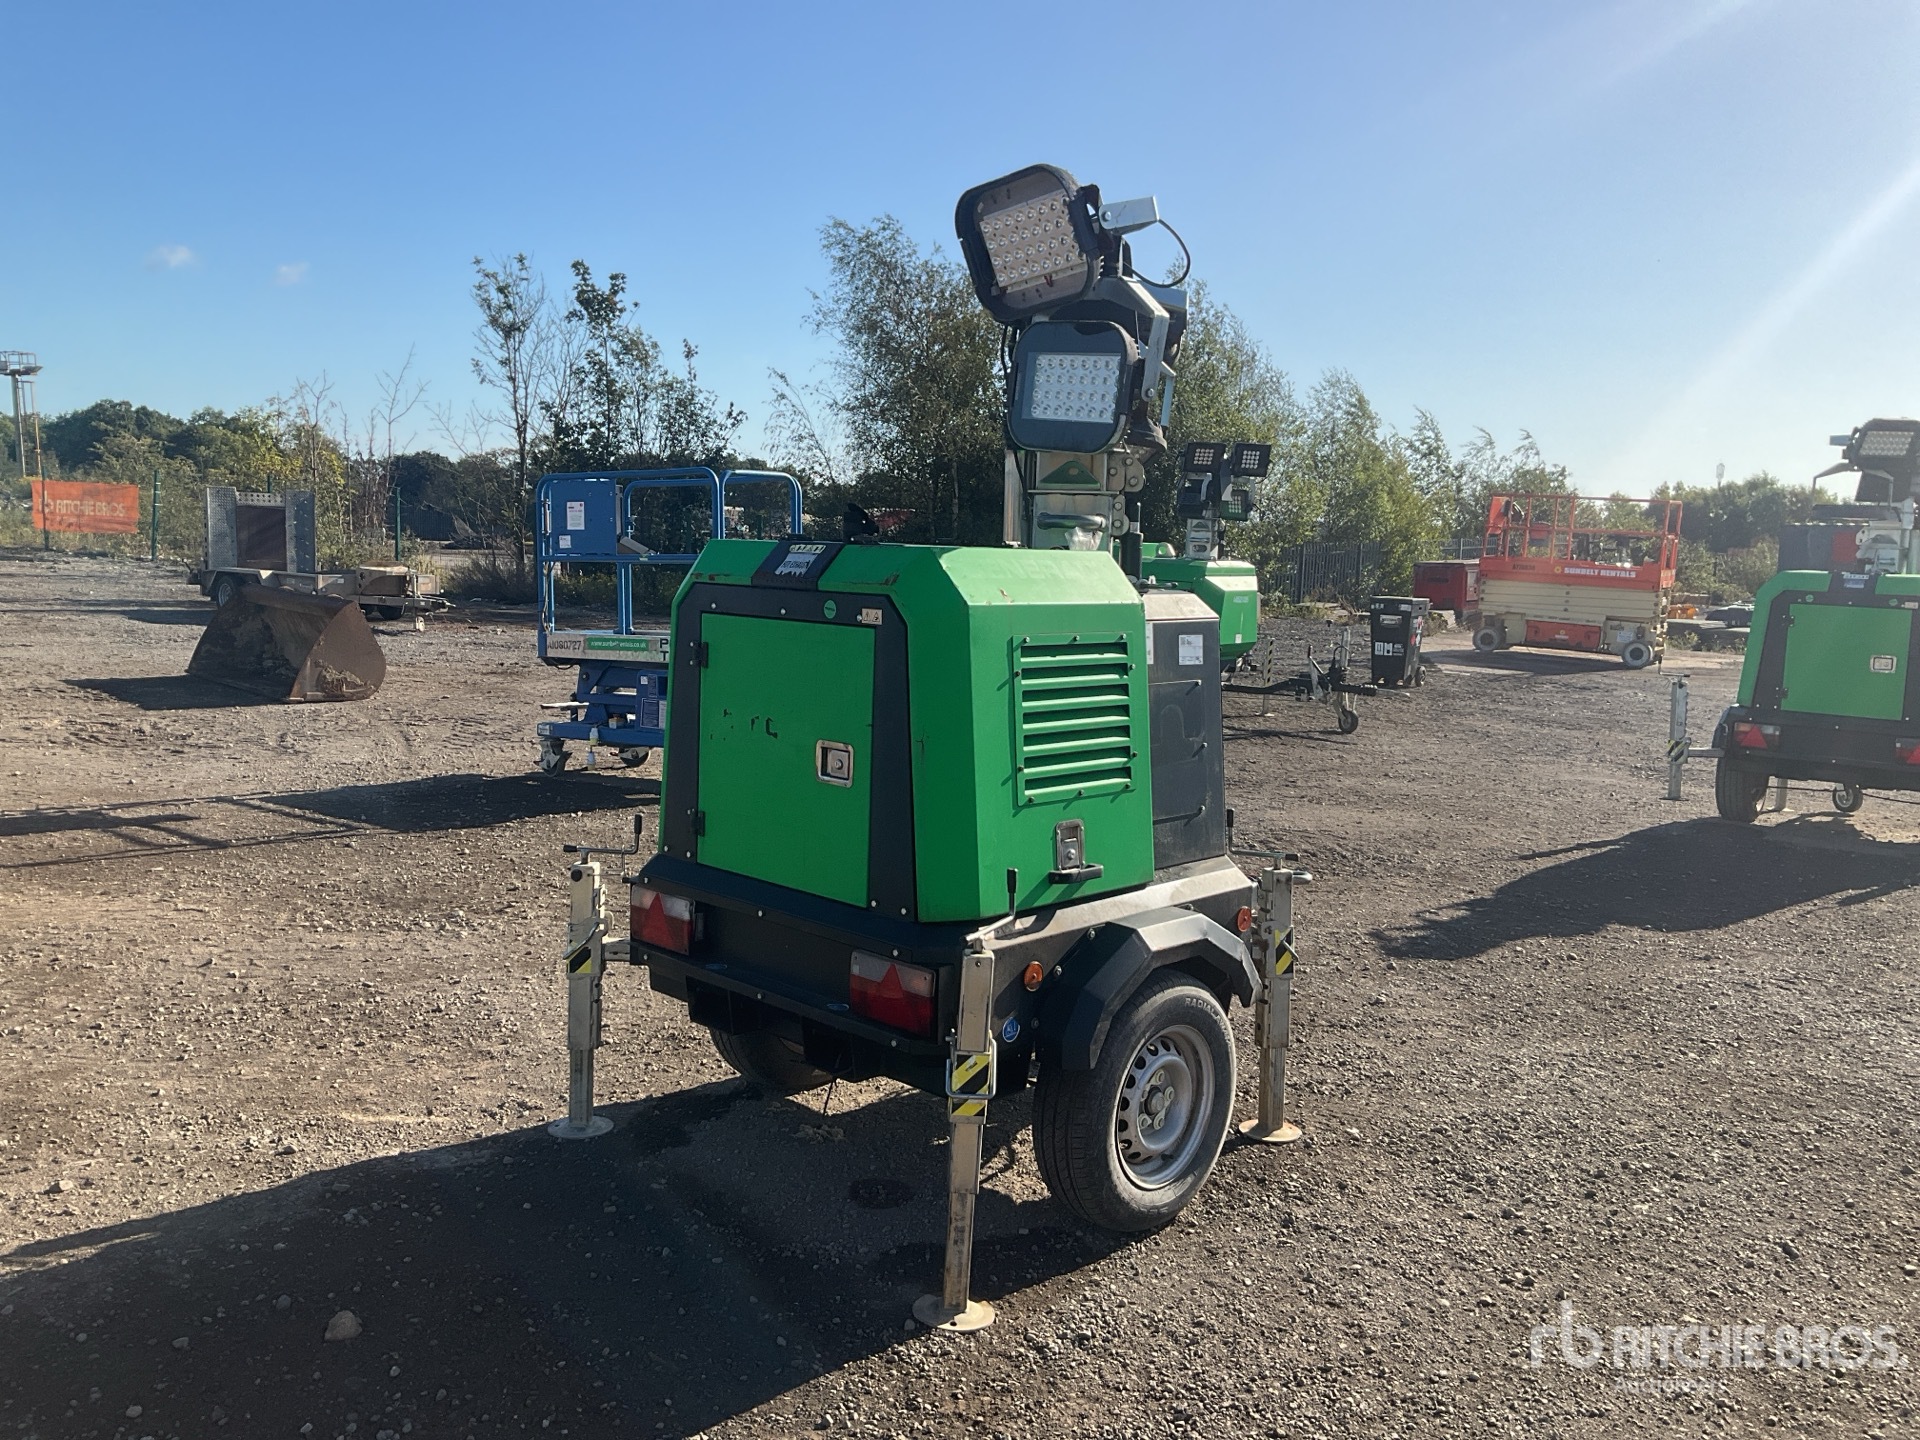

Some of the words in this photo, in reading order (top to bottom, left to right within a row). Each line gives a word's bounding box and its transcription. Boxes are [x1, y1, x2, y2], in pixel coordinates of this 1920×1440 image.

[55, 499, 94, 516] RITCHIE
[1564, 567, 1599, 576] SUNBELT
[1600, 569, 1637, 578] RENTALS
[1185, 997, 1217, 1020] RADIAL
